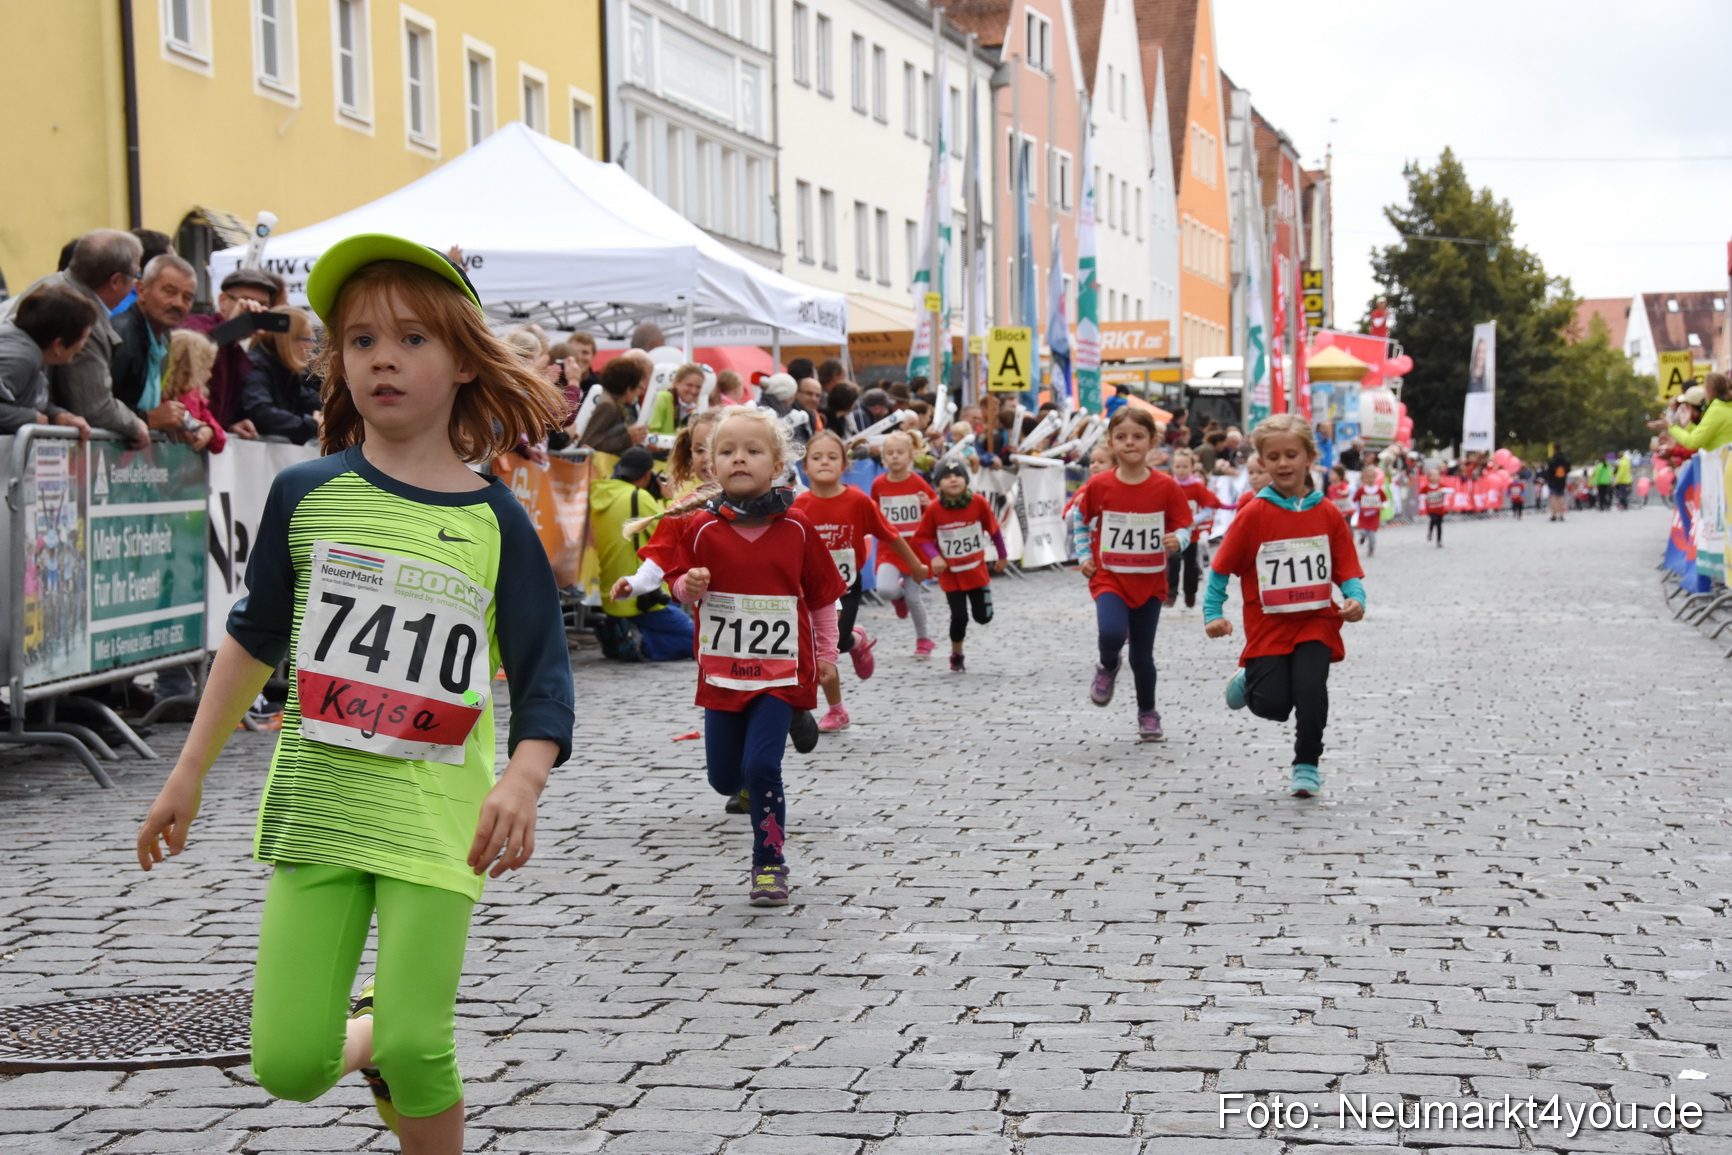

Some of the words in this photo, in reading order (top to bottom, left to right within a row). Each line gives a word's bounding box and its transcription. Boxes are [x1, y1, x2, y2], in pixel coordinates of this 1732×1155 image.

[995, 330, 1027, 341] Block
[998, 347, 1021, 376] A
[1667, 367, 1683, 390] A
[883, 505, 918, 521] 7500
[94, 526, 121, 560] Mehr
[123, 523, 172, 558] Sicherheit
[944, 534, 981, 556] 7254
[1109, 527, 1160, 550] 7415
[321, 564, 384, 586] NeuerMarkt
[1265, 553, 1327, 585] 7118
[393, 588, 424, 601] inspired
[425, 593, 434, 604] by
[436, 597, 458, 610] smart
[396, 564, 480, 613] BOCK
[742, 598, 791, 611] BOCK
[314, 591, 477, 695] 7410
[710, 616, 790, 655] 7122
[731, 662, 761, 676] Anna
[319, 680, 440, 739] Kajsa
